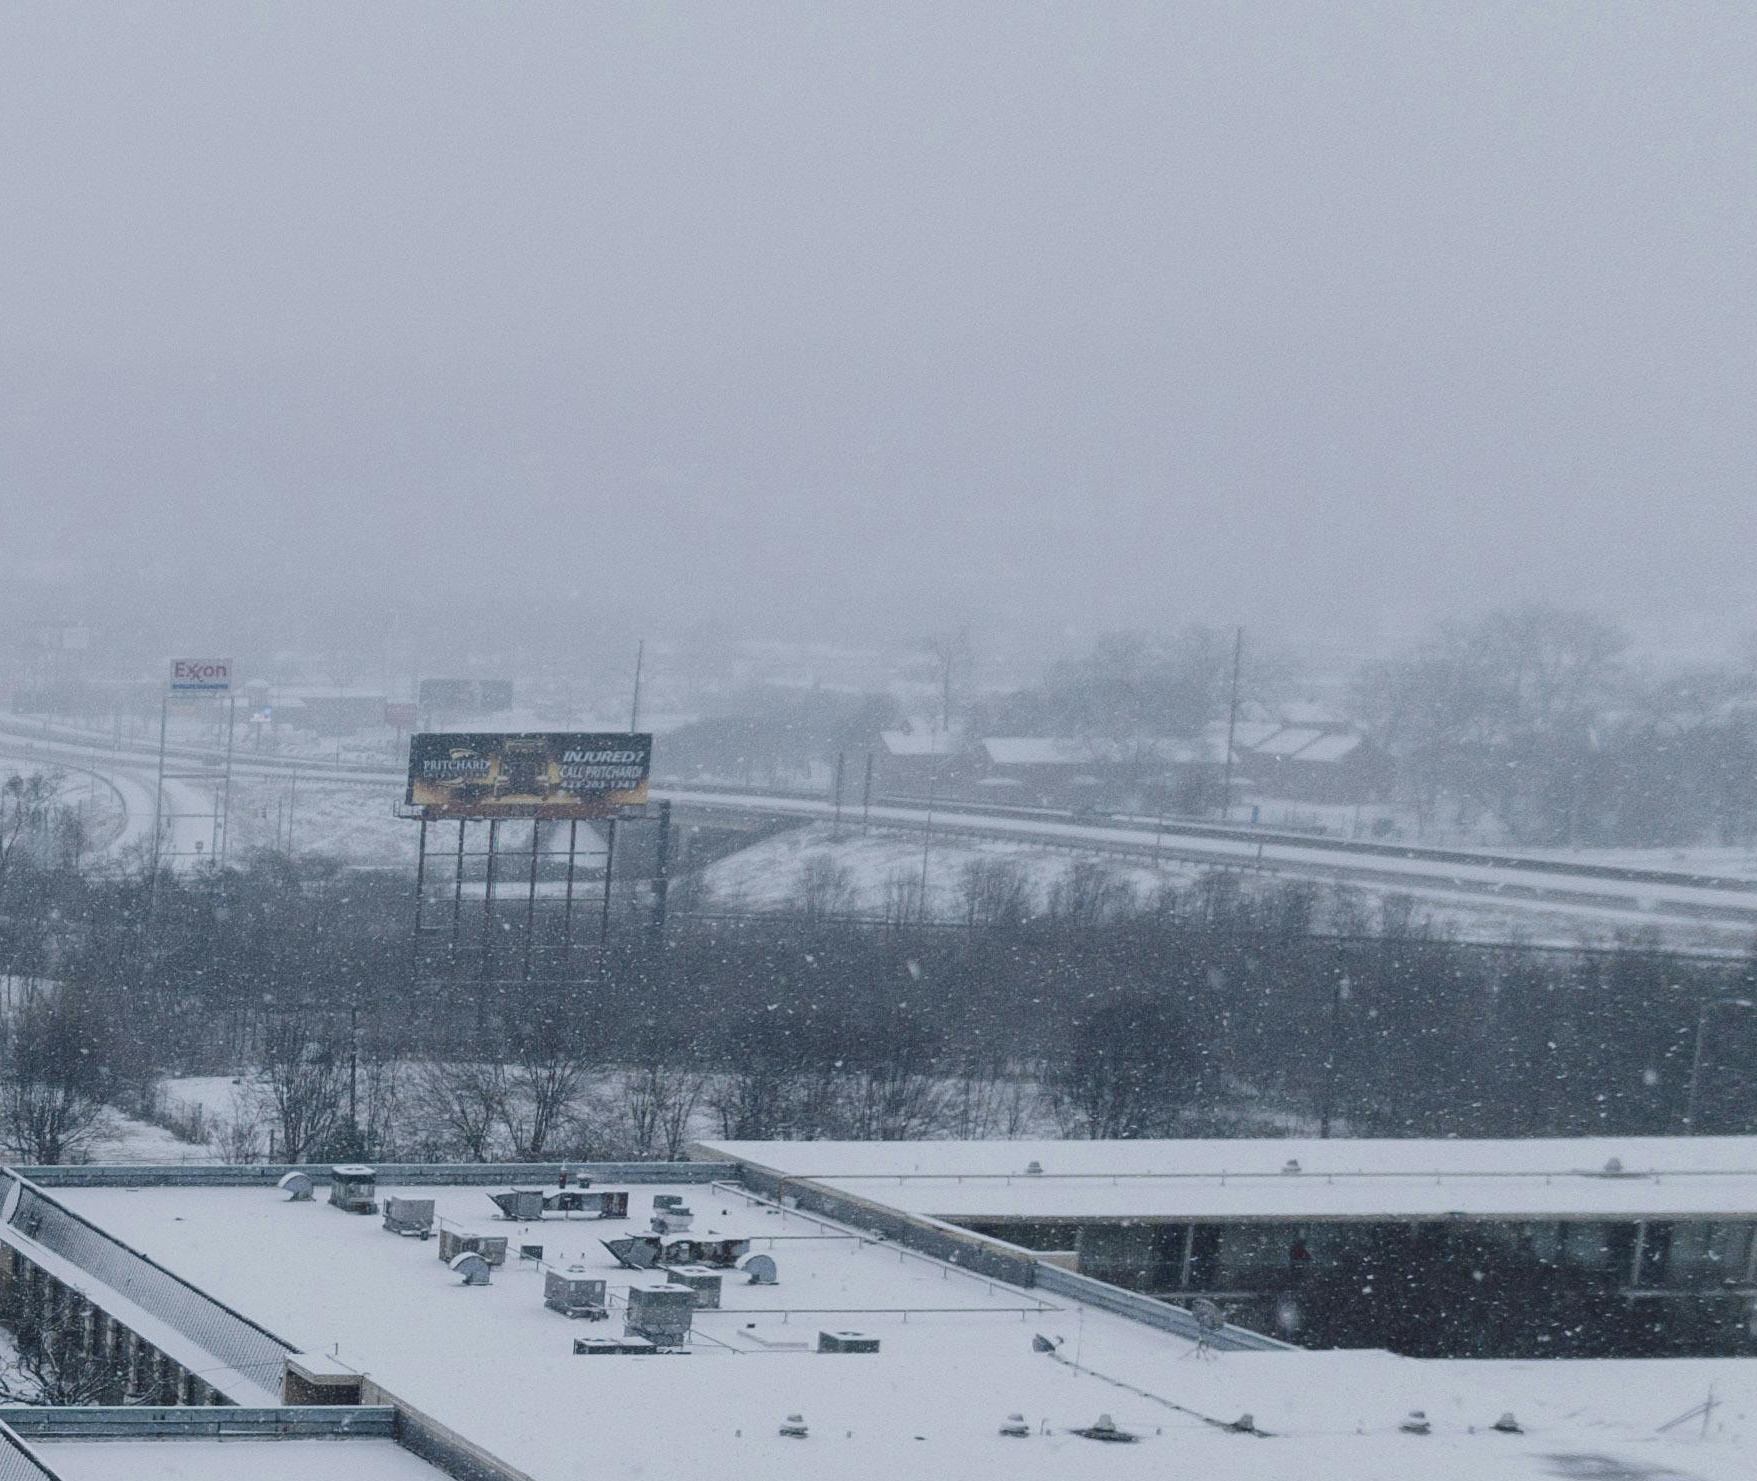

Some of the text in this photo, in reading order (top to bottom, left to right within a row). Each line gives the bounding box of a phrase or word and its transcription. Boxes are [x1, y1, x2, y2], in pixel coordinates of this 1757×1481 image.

[175, 662, 227, 682] Exxon
[563, 751, 645, 762] INJURED?
[423, 760, 490, 771] PRITCHARD
[560, 766, 583, 778] CALL
